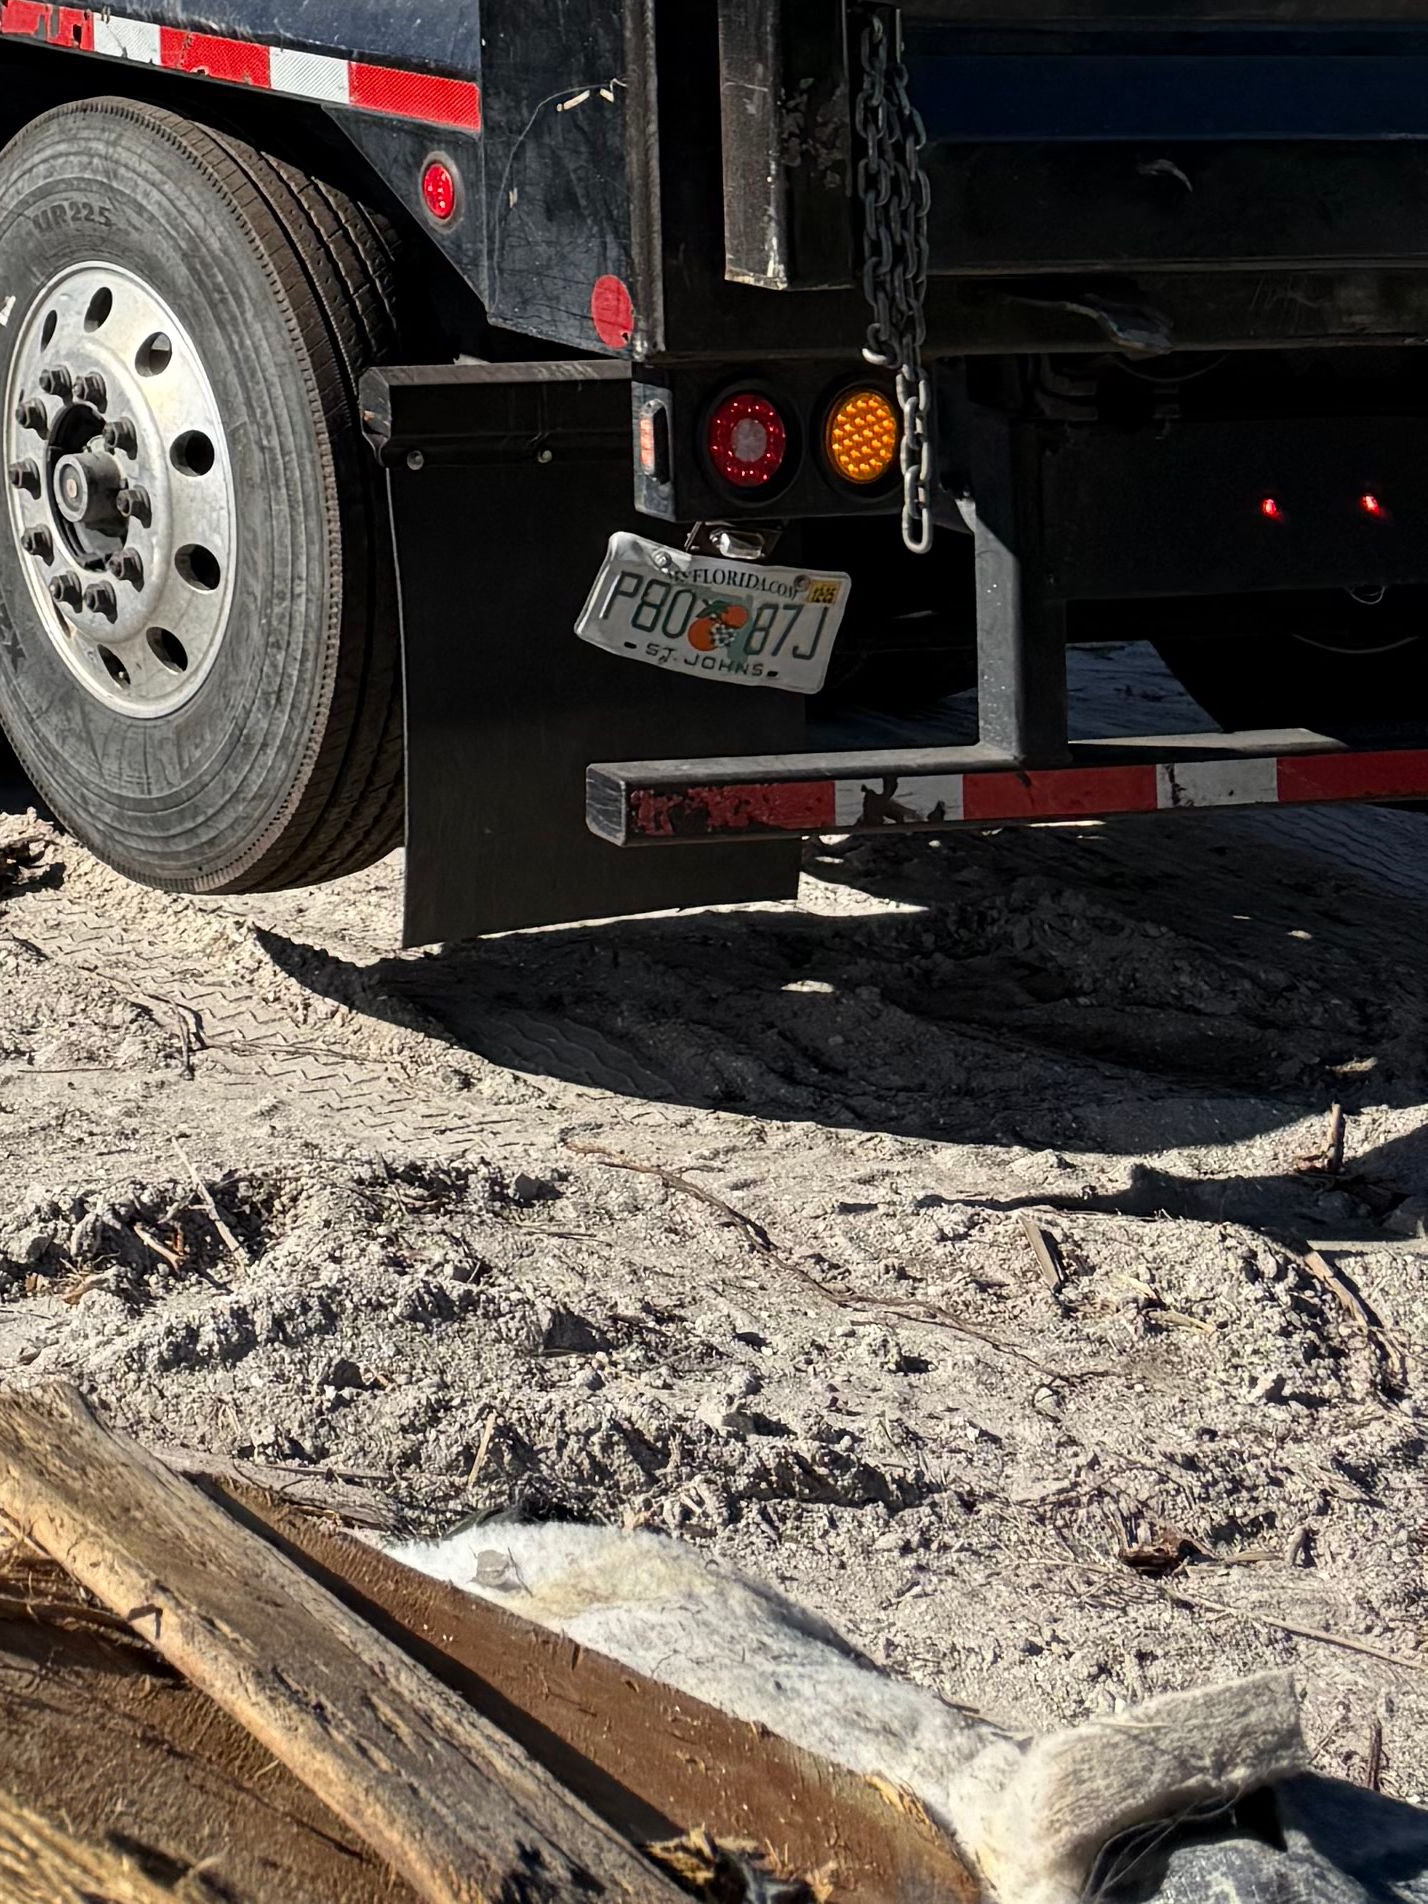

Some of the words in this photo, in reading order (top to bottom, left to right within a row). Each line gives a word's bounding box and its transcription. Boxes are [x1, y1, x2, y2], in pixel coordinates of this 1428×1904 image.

[599, 570, 696, 639] P80
[744, 602, 830, 660] 87J
[683, 653, 766, 677] JOHNS
